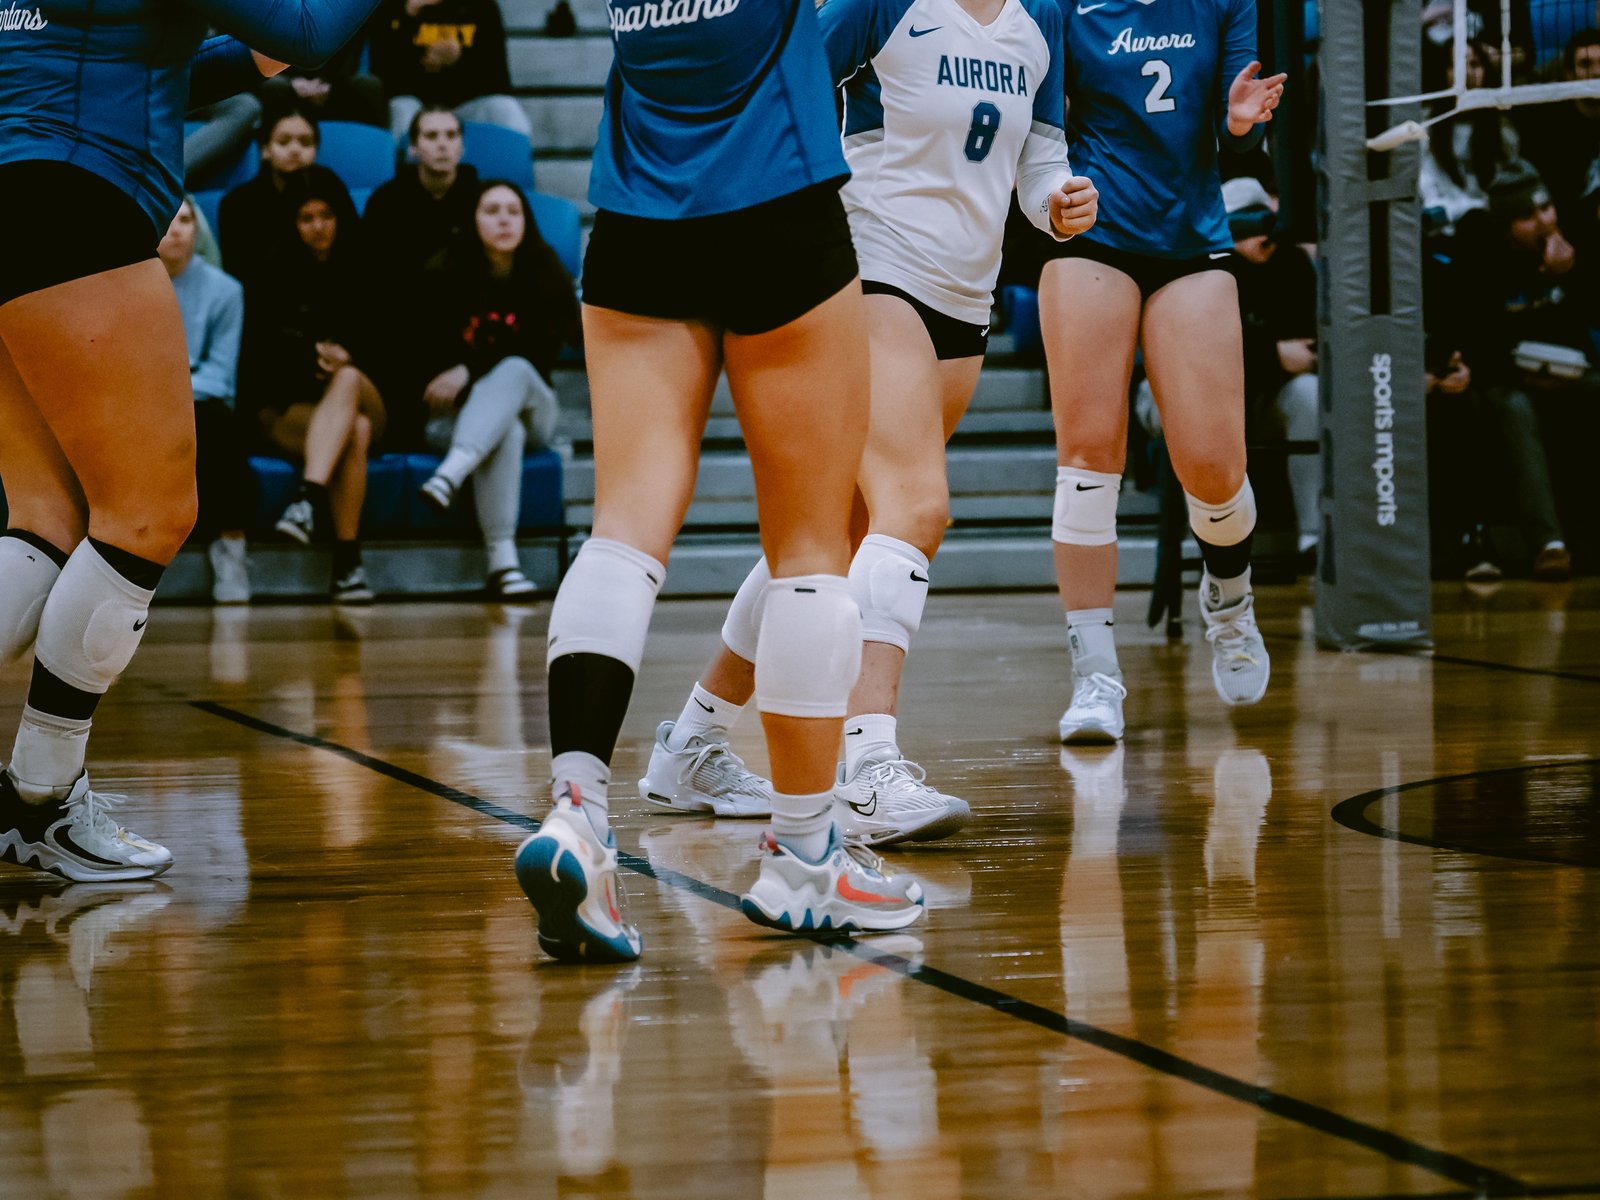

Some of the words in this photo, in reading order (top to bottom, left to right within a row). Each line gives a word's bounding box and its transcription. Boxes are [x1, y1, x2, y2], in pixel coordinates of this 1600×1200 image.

[1107, 27, 1196, 56] Aurora
[937, 54, 1029, 97] AURORA
[1140, 58, 1177, 114] 2
[963, 100, 1003, 164] 8
[1368, 352, 1397, 430] sports
[1371, 431, 1399, 527] imports
